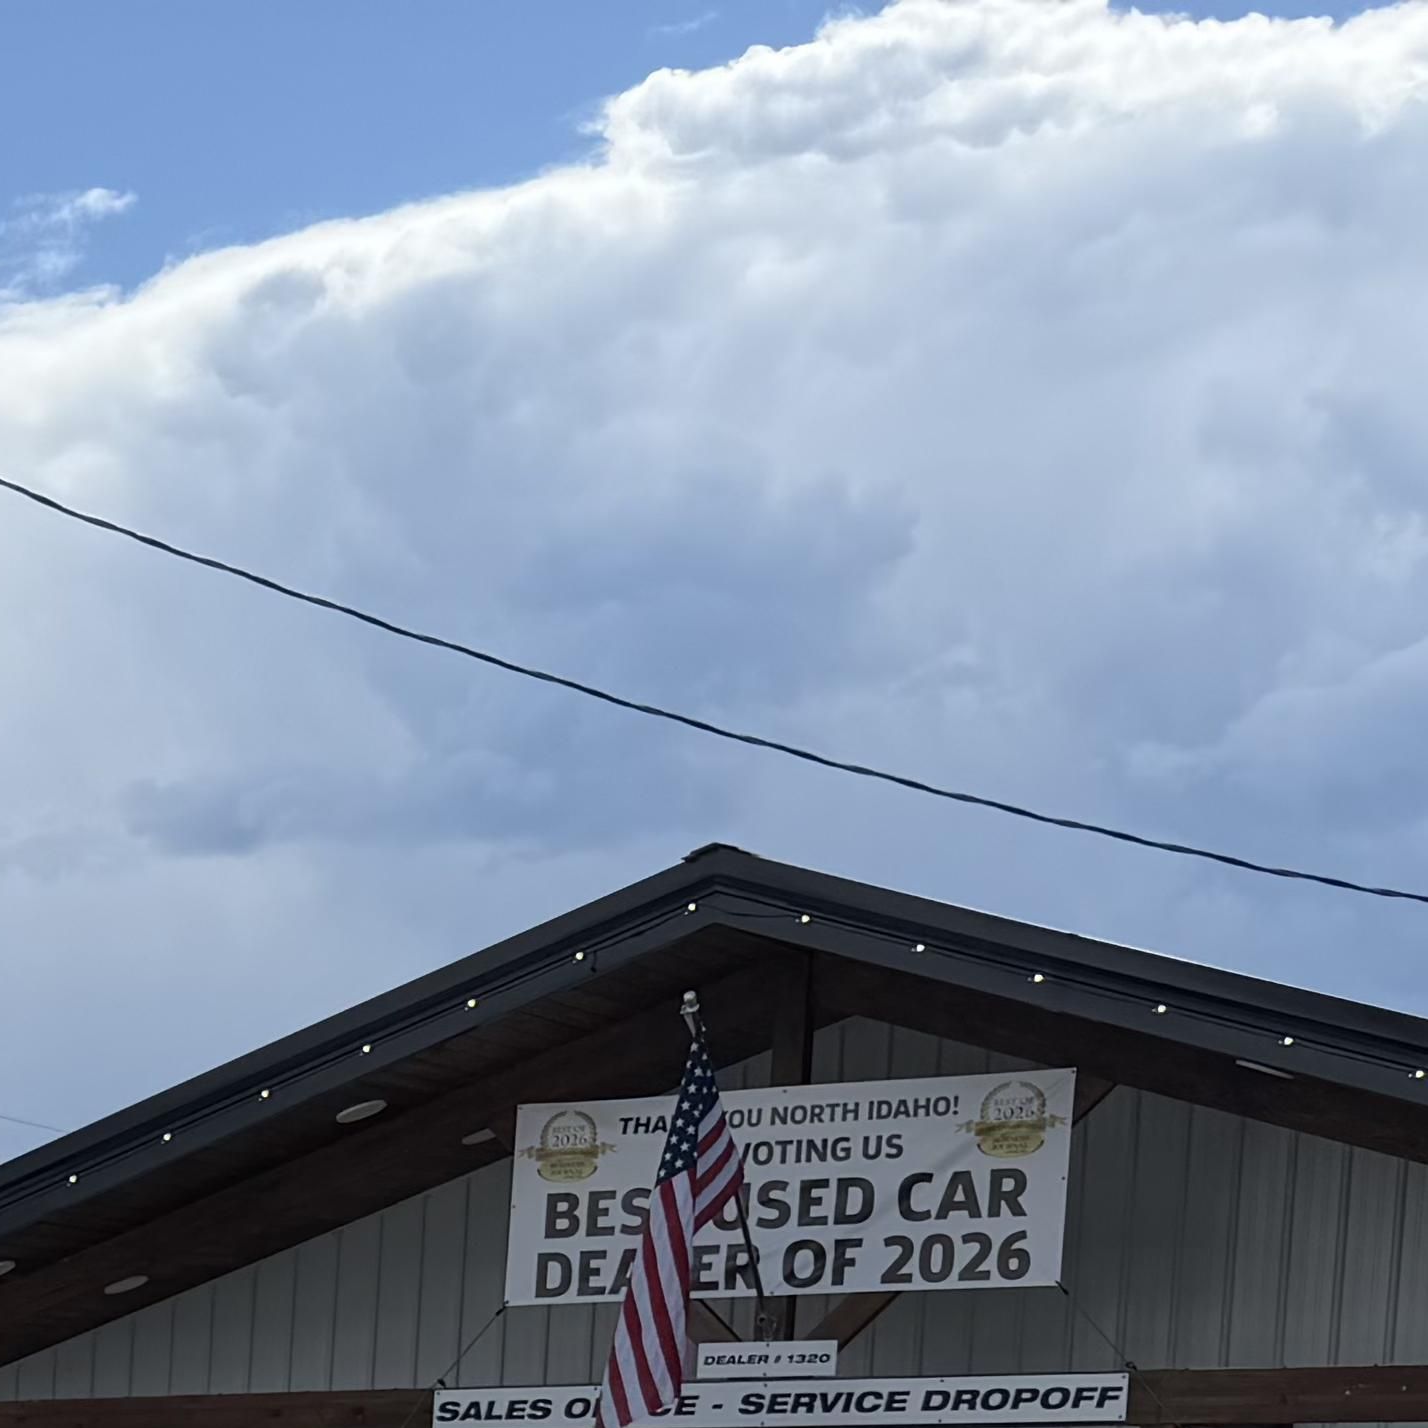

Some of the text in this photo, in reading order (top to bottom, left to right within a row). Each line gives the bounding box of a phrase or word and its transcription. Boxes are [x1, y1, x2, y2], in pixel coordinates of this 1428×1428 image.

[619, 1095, 960, 1136] THA OU NORTH IDAHO!
[993, 1105, 1035, 1120] 2026
[552, 1133, 588, 1148] 2026
[862, 1133, 904, 1160] US
[544, 1167, 1028, 1239] BES USED CAR
[534, 1230, 1031, 1298] DEAER OF 2026
[703, 1354, 770, 1366] DEALER
[787, 1353, 831, 1364] 1320
[435, 1398, 553, 1422] SALES
[737, 1390, 911, 1416] SERVICE
[920, 1386, 1124, 1412] DROPOFF
